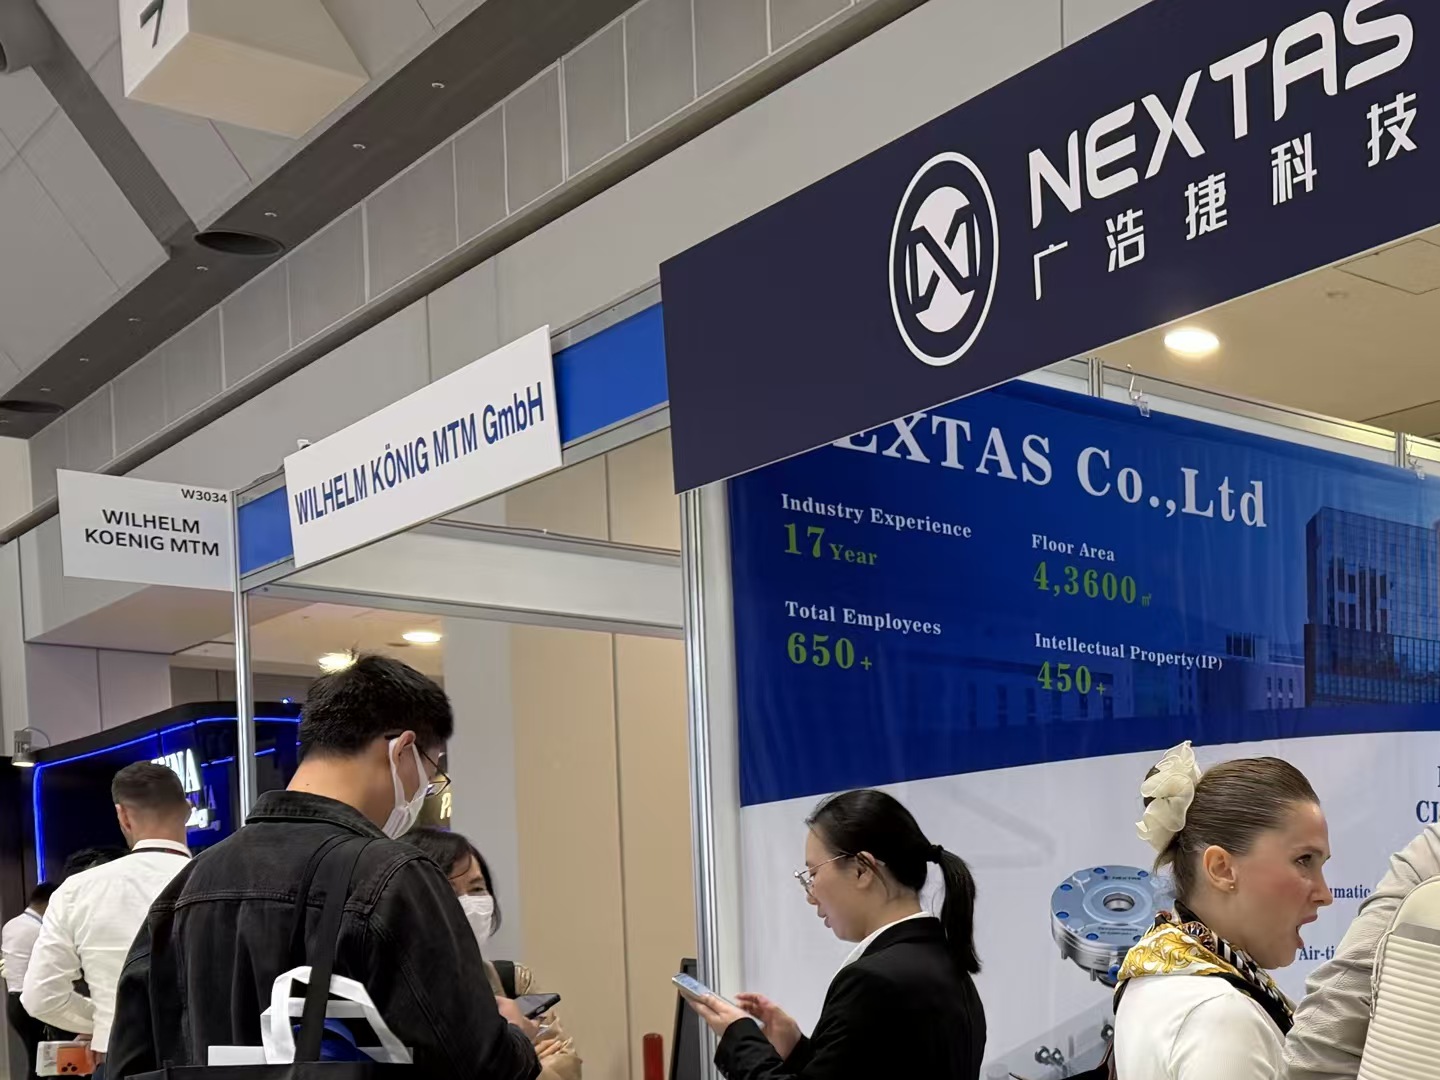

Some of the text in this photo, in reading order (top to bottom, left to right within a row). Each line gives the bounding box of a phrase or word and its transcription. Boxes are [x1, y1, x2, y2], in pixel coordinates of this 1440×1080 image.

[1027, 0, 1414, 229] NEXTAS
[1033, 92, 1418, 301] 广浩捷科技
[294, 381, 544, 525] WILHELM KÖNIG MTM GmbH
[181, 488, 227, 503] W3034
[1076, 445, 1267, 528] Co.,Ltd
[102, 509, 200, 534] WILHELM
[781, 493, 972, 539] Industry Experience
[85, 528, 219, 556] KOENIG MTM
[1031, 533, 1116, 563] Floor Area
[784, 599, 942, 637] Total Employees
[1034, 632, 1223, 671] Intellectual Property(IP)
[1330, 885, 1371, 898] matic
